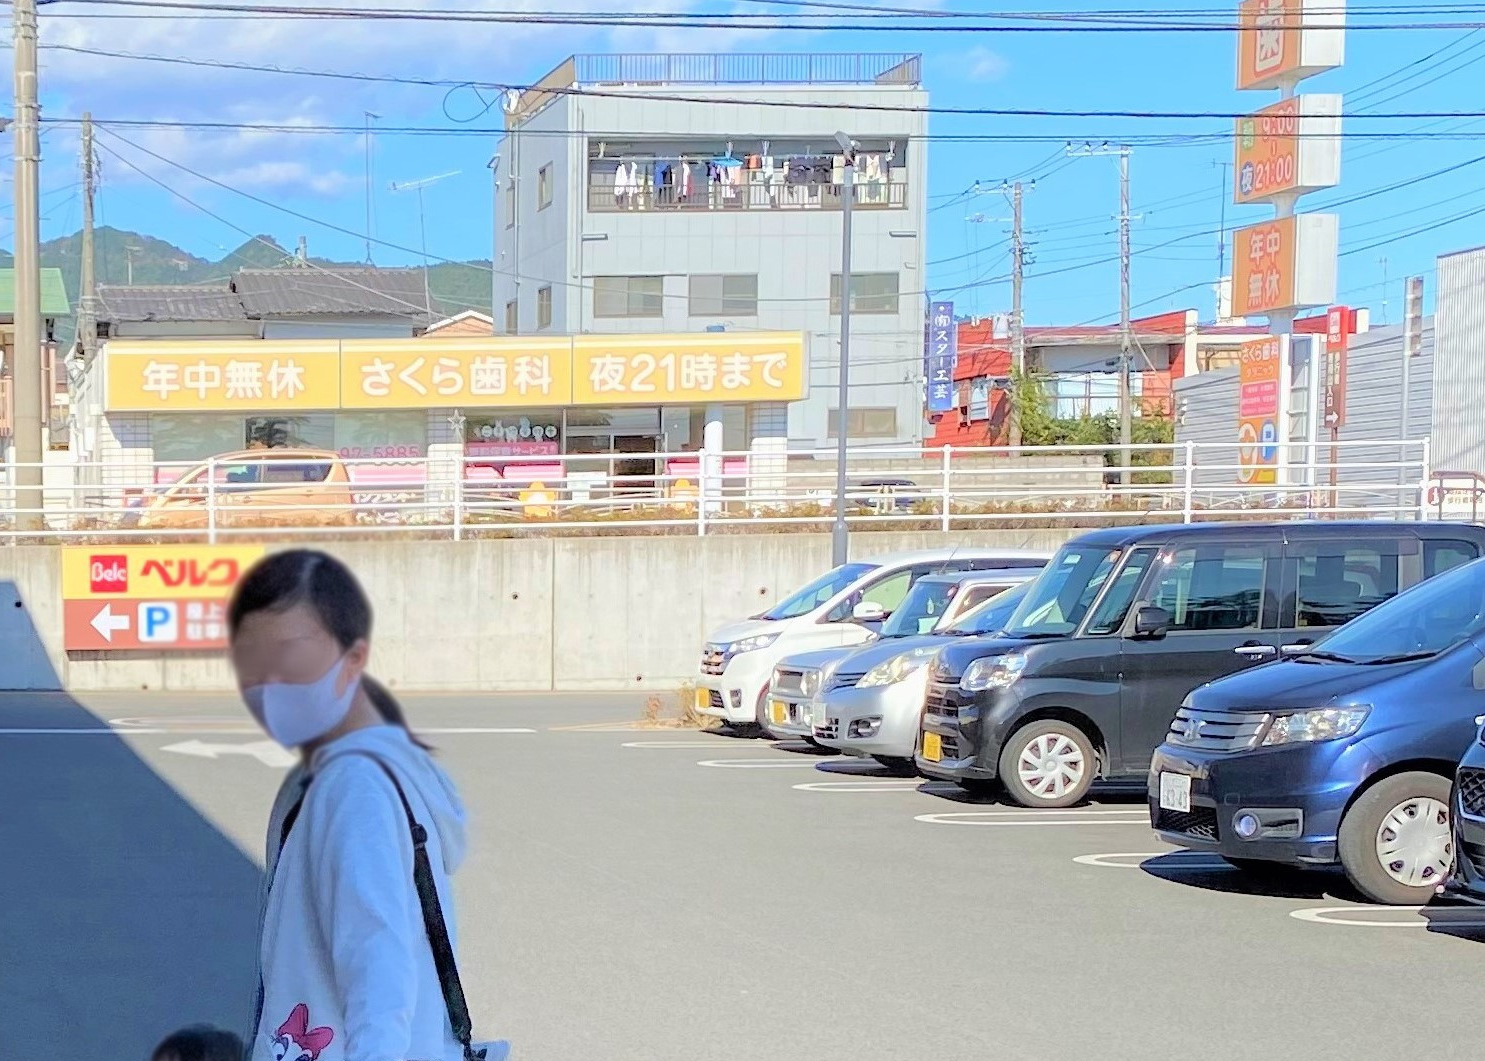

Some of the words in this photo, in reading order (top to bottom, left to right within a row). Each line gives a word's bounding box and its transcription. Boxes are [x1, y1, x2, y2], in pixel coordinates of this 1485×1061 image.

[1256, 155, 1292, 190] 21:00
[1250, 226, 1281, 266] 年中
[1248, 268, 1280, 306] 無休
[1241, 341, 1279, 363] さくら歯科
[141, 358, 306, 401] 年中無休
[360, 355, 553, 396] さくら歯科
[588, 350, 788, 394] 夜21時まで
[91, 561, 127, 582] Belc
[139, 559, 241, 587] ベルク
[146, 606, 170, 637] P
